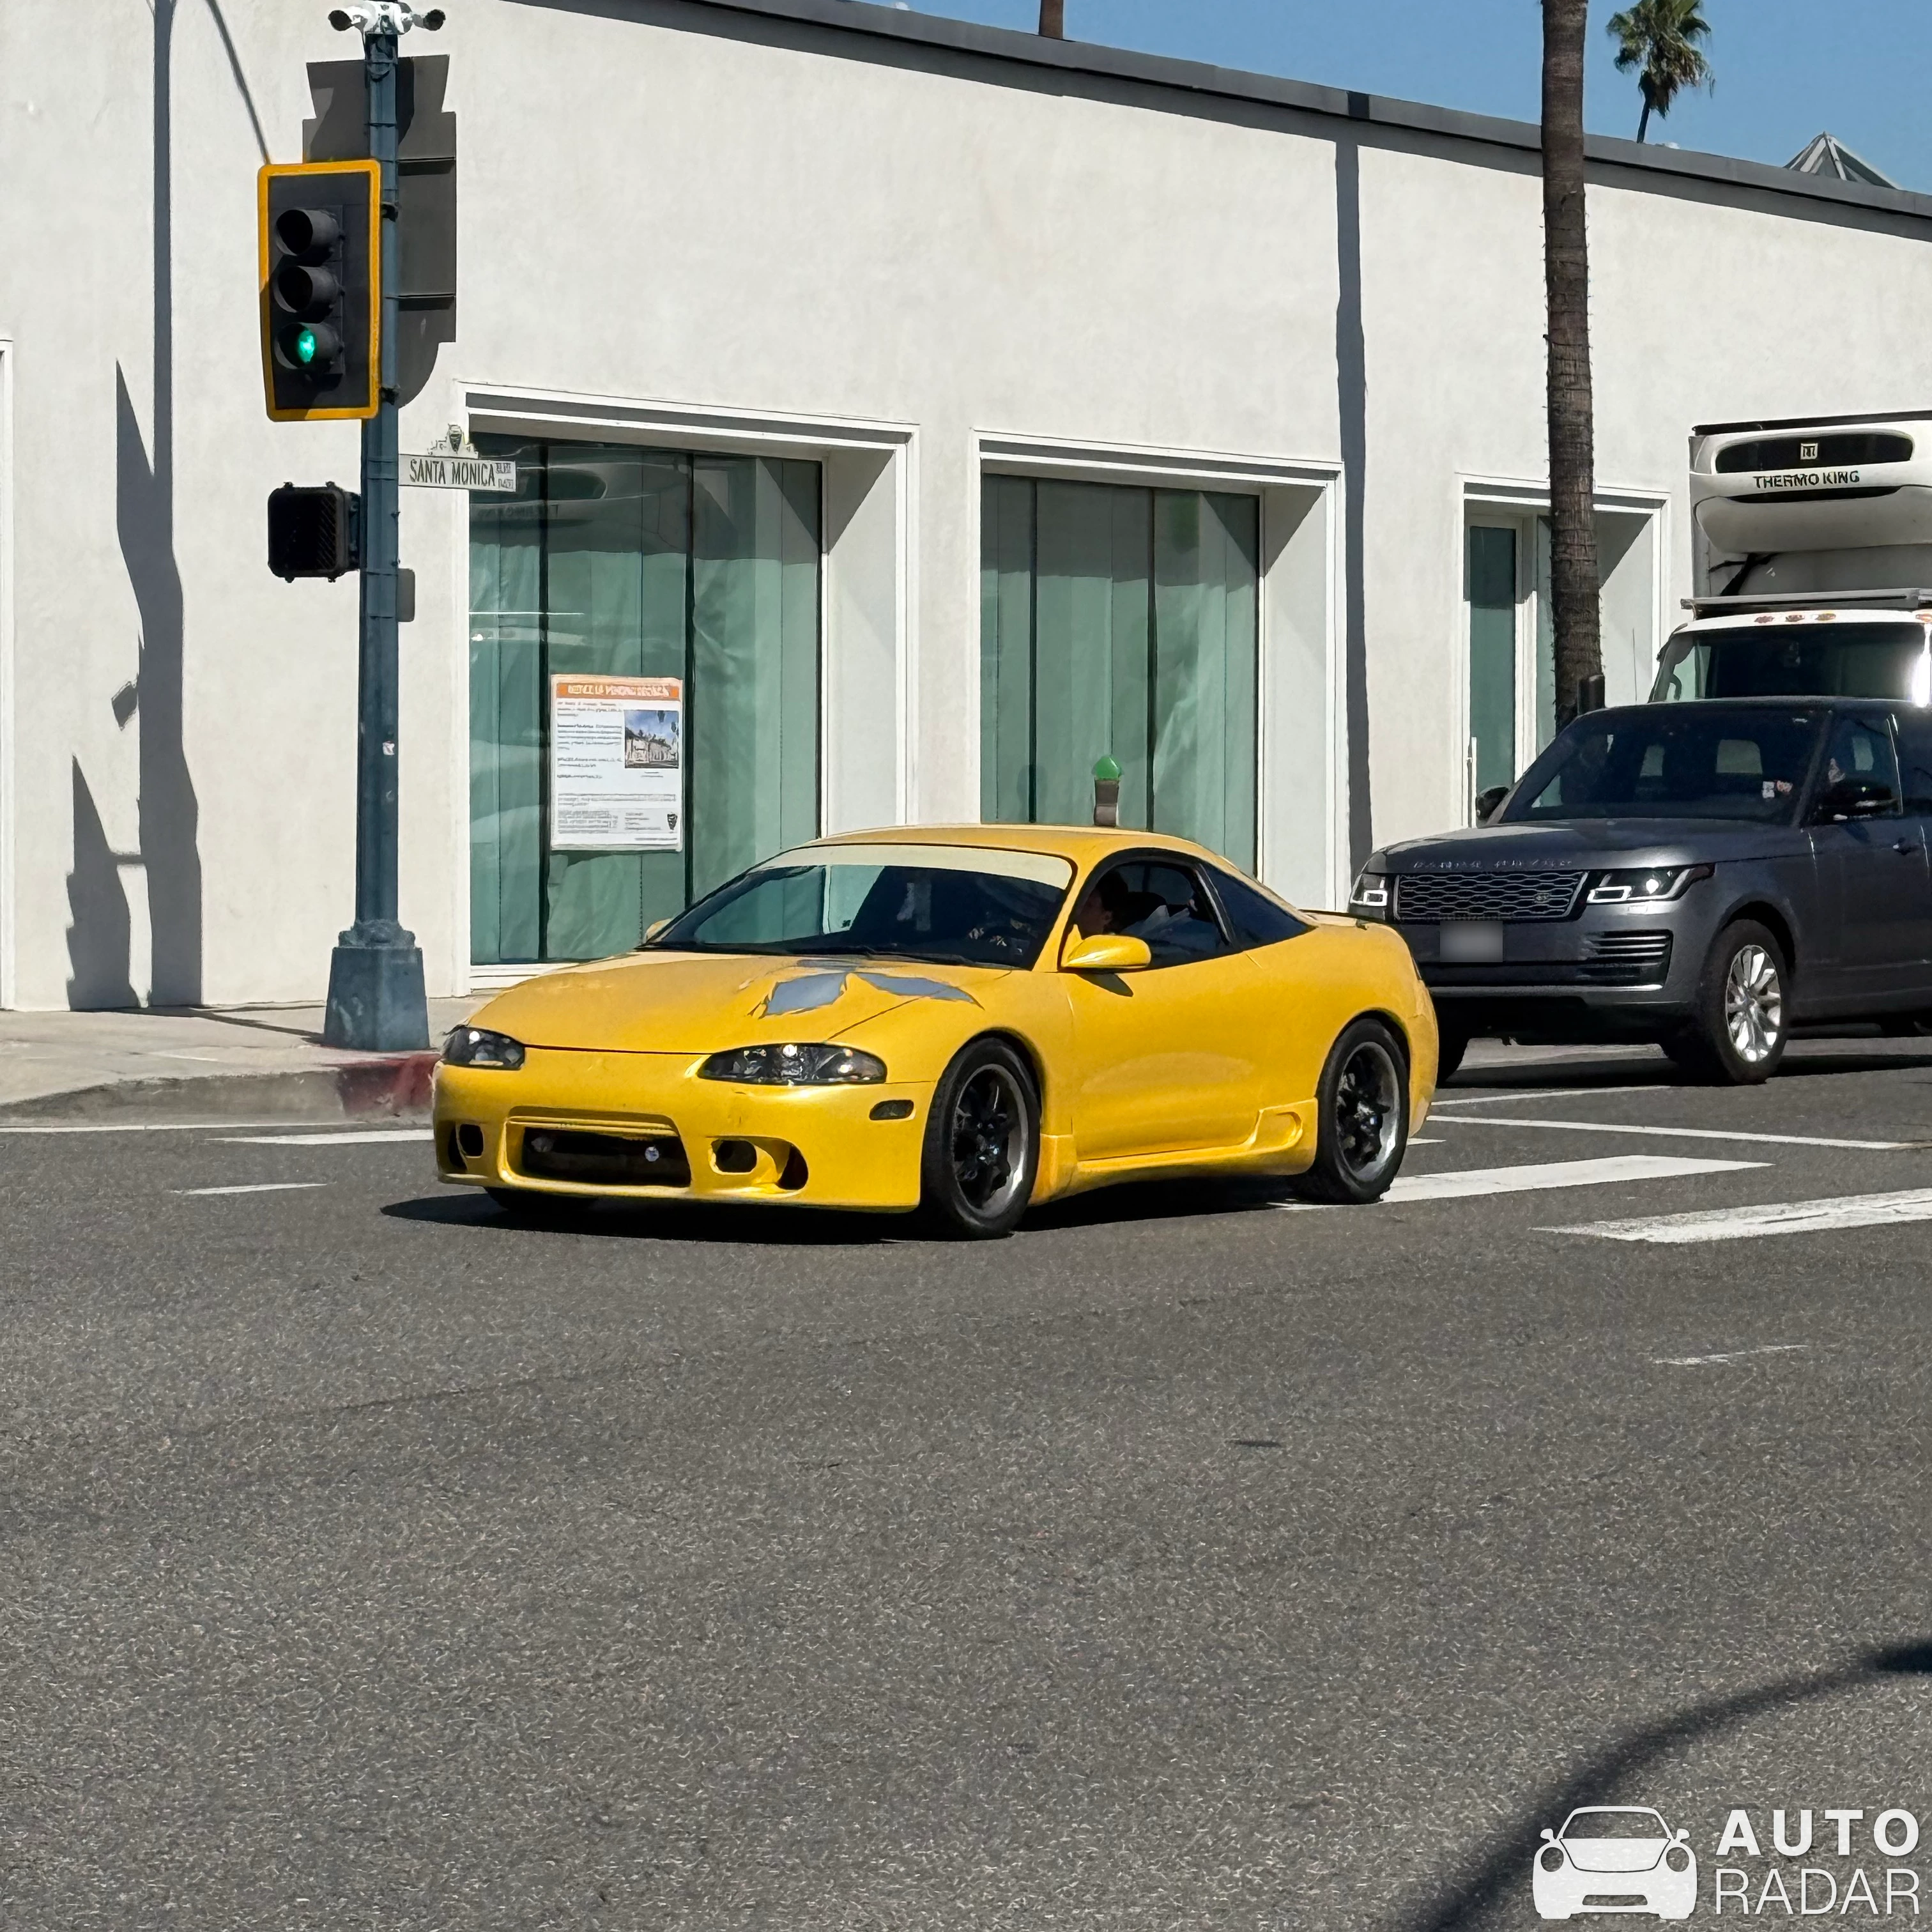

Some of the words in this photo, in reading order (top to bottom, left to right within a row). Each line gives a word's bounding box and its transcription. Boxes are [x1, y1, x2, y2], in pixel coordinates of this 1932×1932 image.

[410, 459, 446, 484] SANTA
[451, 461, 495, 486] MONICA
[1753, 473, 1820, 489] THERMO
[1823, 470, 1860, 484] KING
